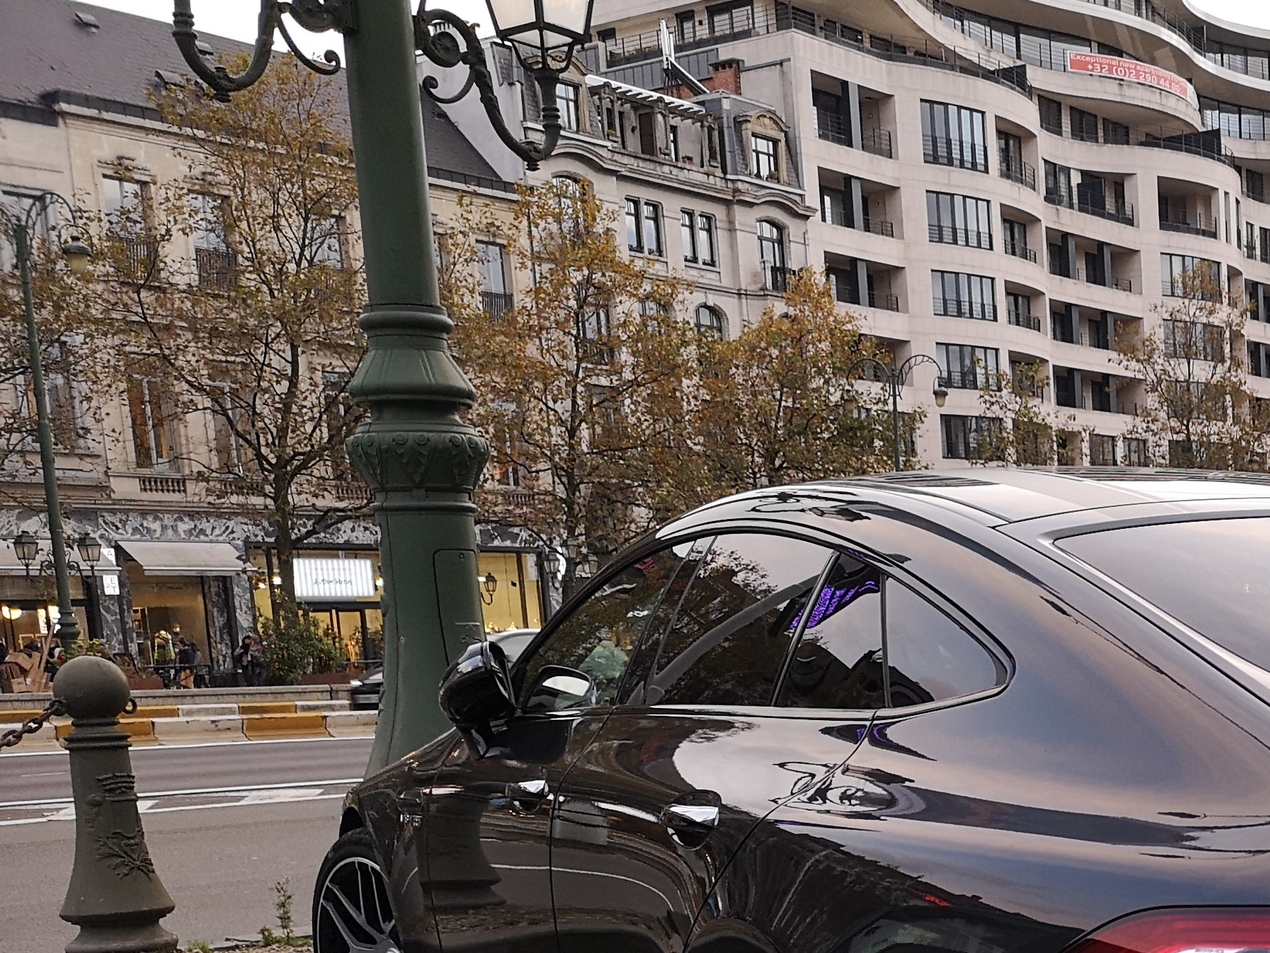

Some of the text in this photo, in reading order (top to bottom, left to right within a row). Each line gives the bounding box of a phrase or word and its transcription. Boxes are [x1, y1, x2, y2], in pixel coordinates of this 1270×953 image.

[1070, 53, 1119, 66] Exceptional
[1120, 61, 1136, 70] new
[1087, 63, 1109, 74] +32
[1112, 67, 1137, 79] (0)2
[1139, 72, 1158, 84] 290
